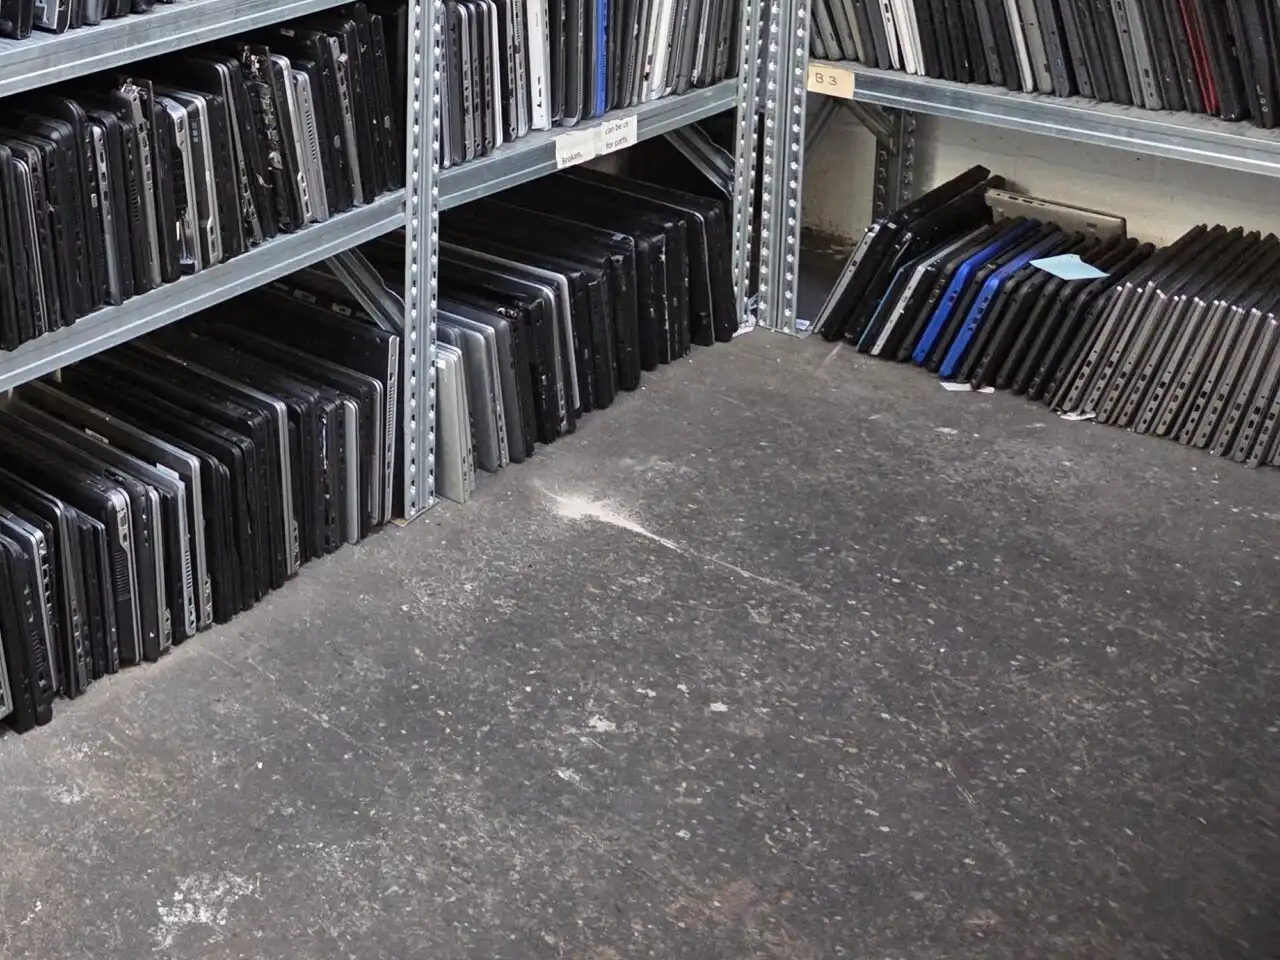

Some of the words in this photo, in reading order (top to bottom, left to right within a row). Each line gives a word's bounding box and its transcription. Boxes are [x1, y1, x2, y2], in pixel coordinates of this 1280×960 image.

[815, 72, 838, 86] B3
[604, 126, 615, 135] can
[615, 123, 622, 131] be
[605, 141, 614, 149] for
